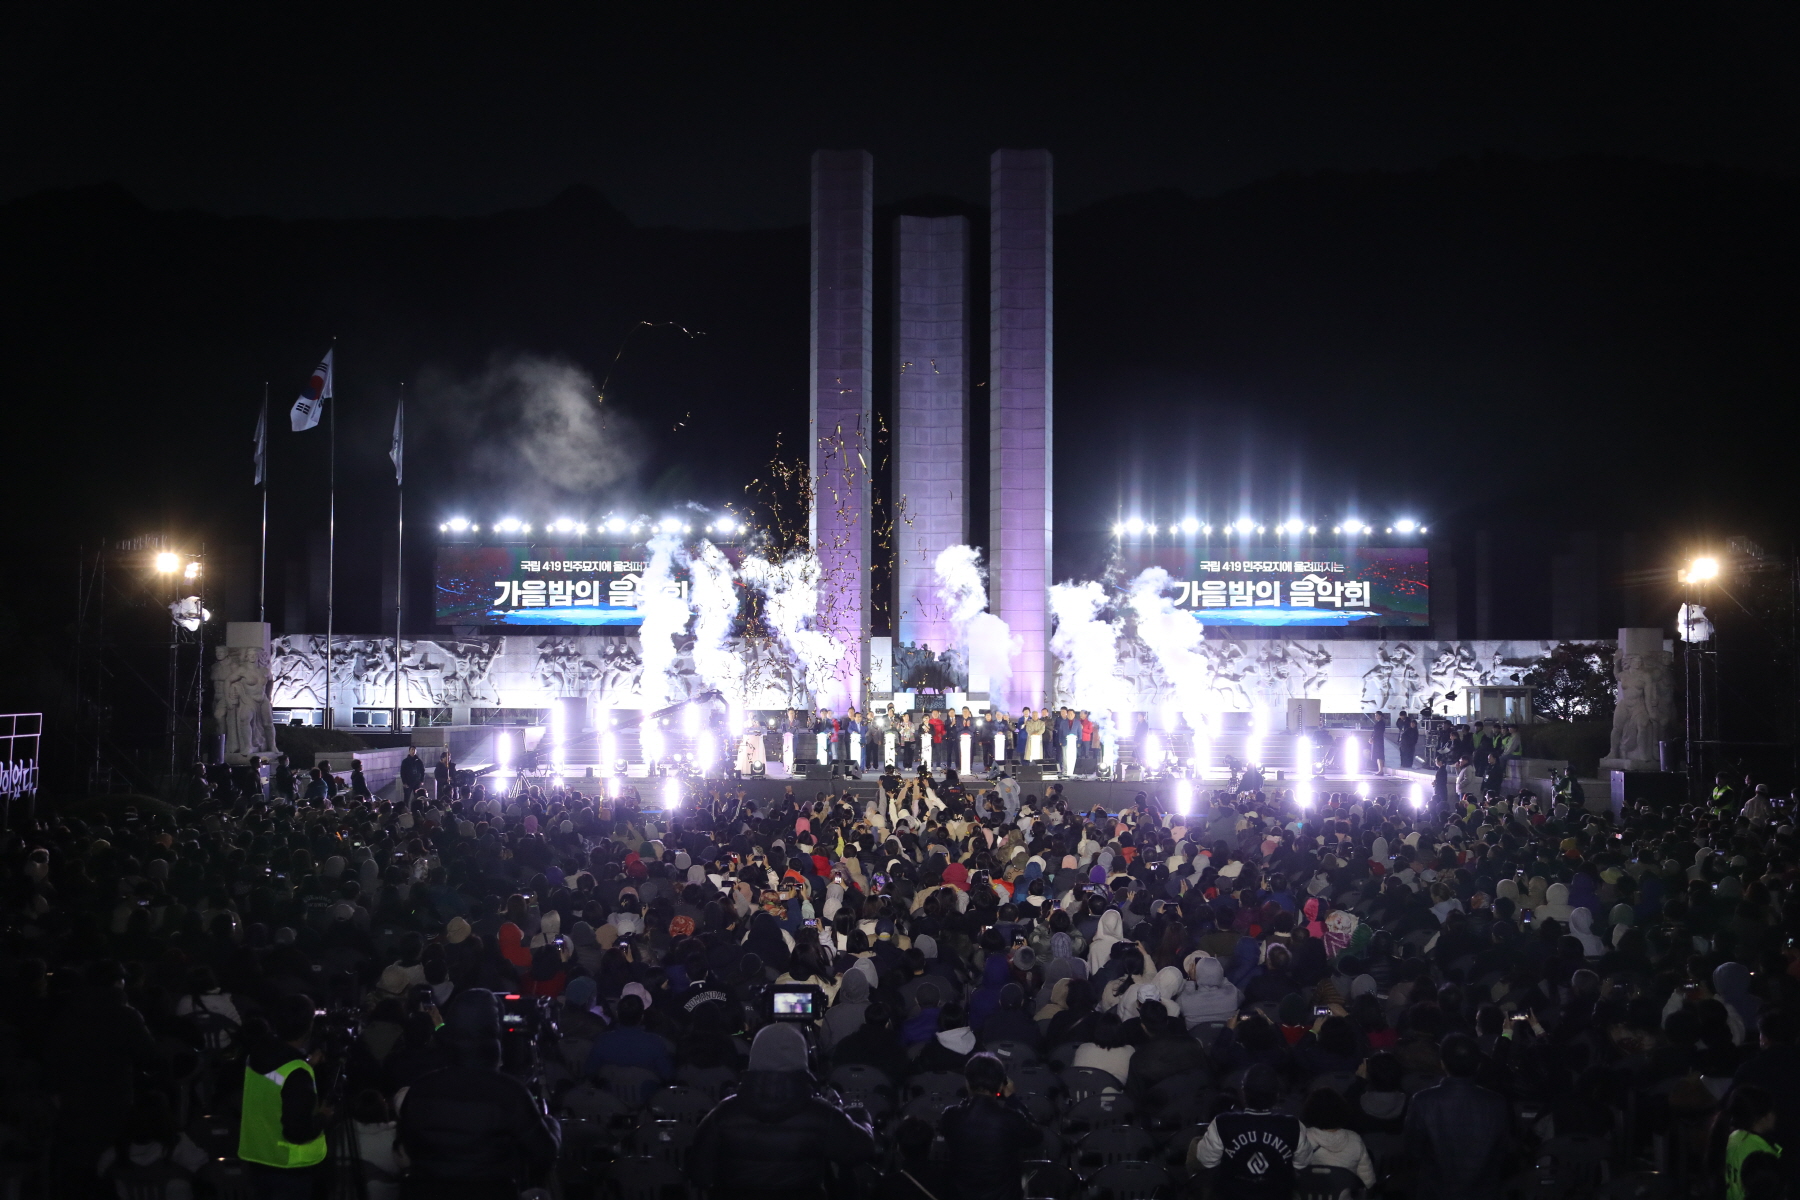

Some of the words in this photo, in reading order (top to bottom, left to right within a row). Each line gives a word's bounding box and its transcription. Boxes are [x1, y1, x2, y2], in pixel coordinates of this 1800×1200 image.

[520, 560, 540, 572] 국립
[563, 560, 611, 572] 민주묘지에
[1200, 561, 1221, 573] 국립
[1243, 561, 1292, 573] 민주묘지에
[1294, 561, 1344, 573] 울려퍼지는
[493, 580, 599, 606] 가을밤의
[1174, 581, 1281, 607] 가을밤의
[1289, 574, 1371, 608] 음악회
[1224, 1131, 1257, 1158] AJOU
[1262, 1132, 1292, 1164] UNIV.
